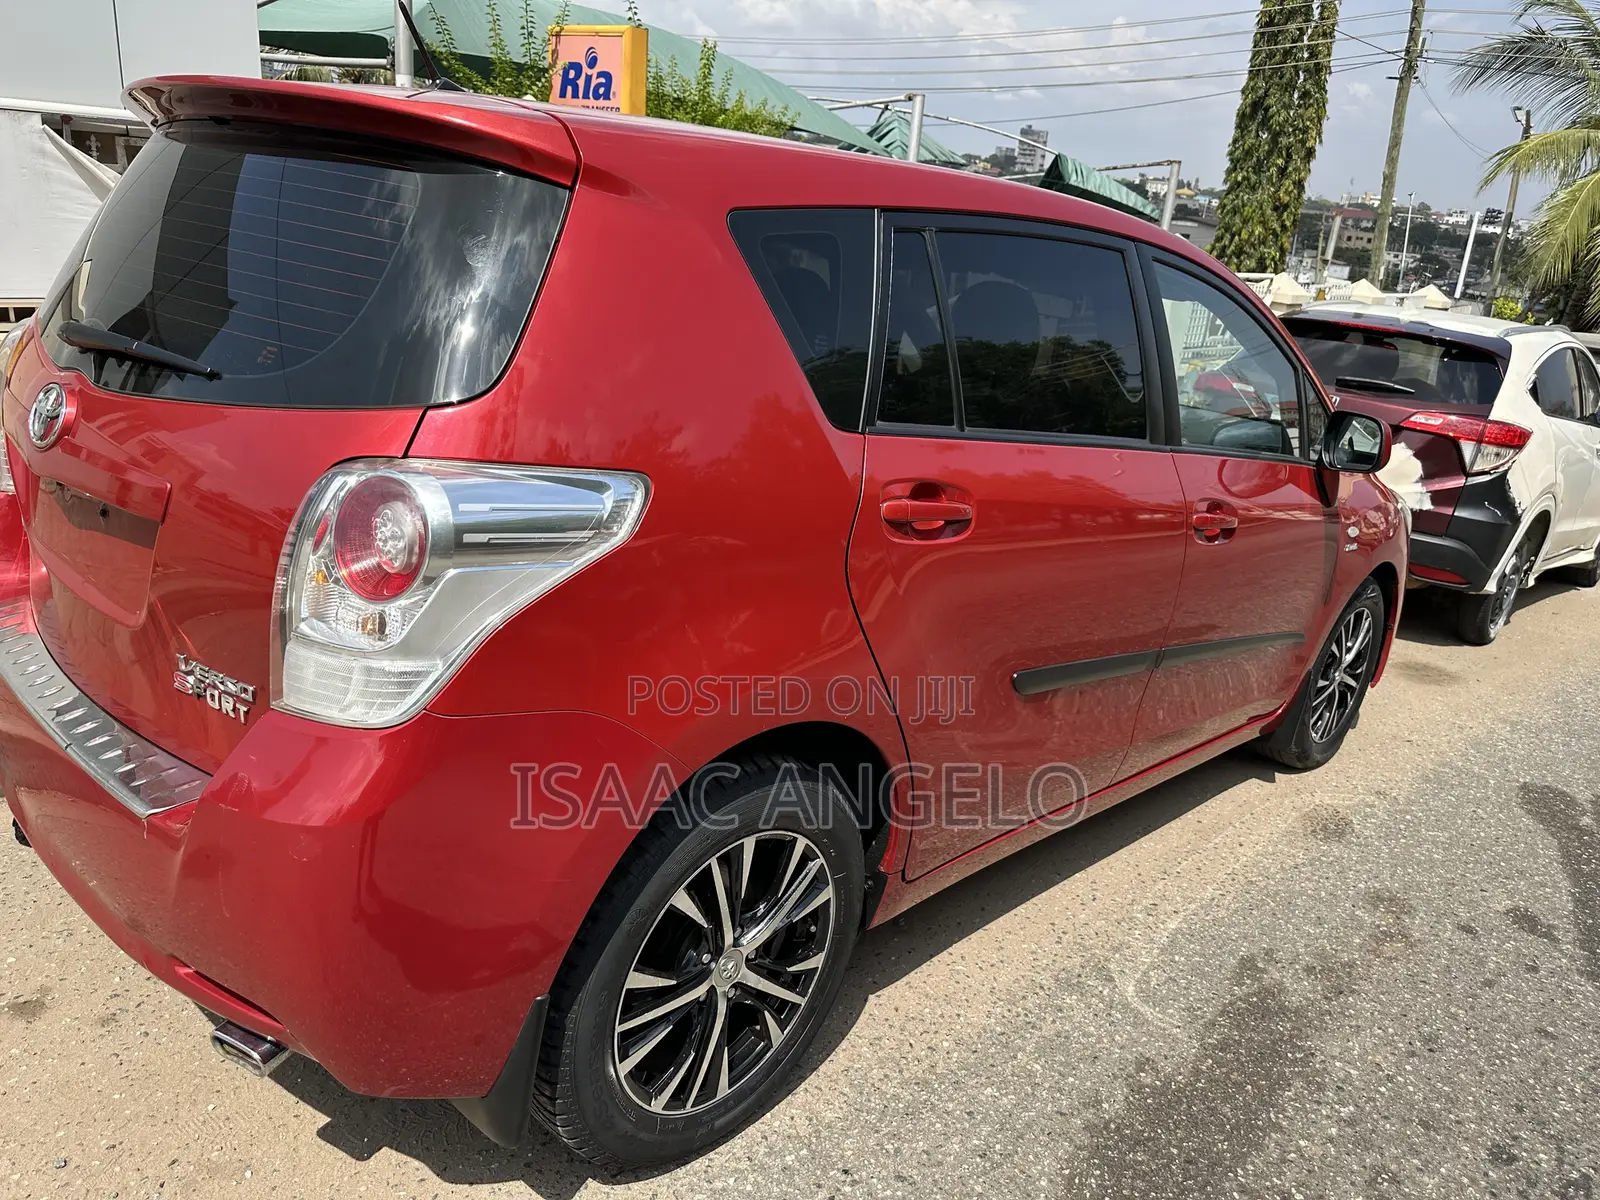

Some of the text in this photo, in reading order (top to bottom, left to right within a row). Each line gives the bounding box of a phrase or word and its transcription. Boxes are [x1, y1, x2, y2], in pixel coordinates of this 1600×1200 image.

[559, 46, 613, 101] Ria
[581, 105, 620, 113] SFER
[173, 671, 250, 724] SPORT
[176, 653, 256, 702] VERSO
